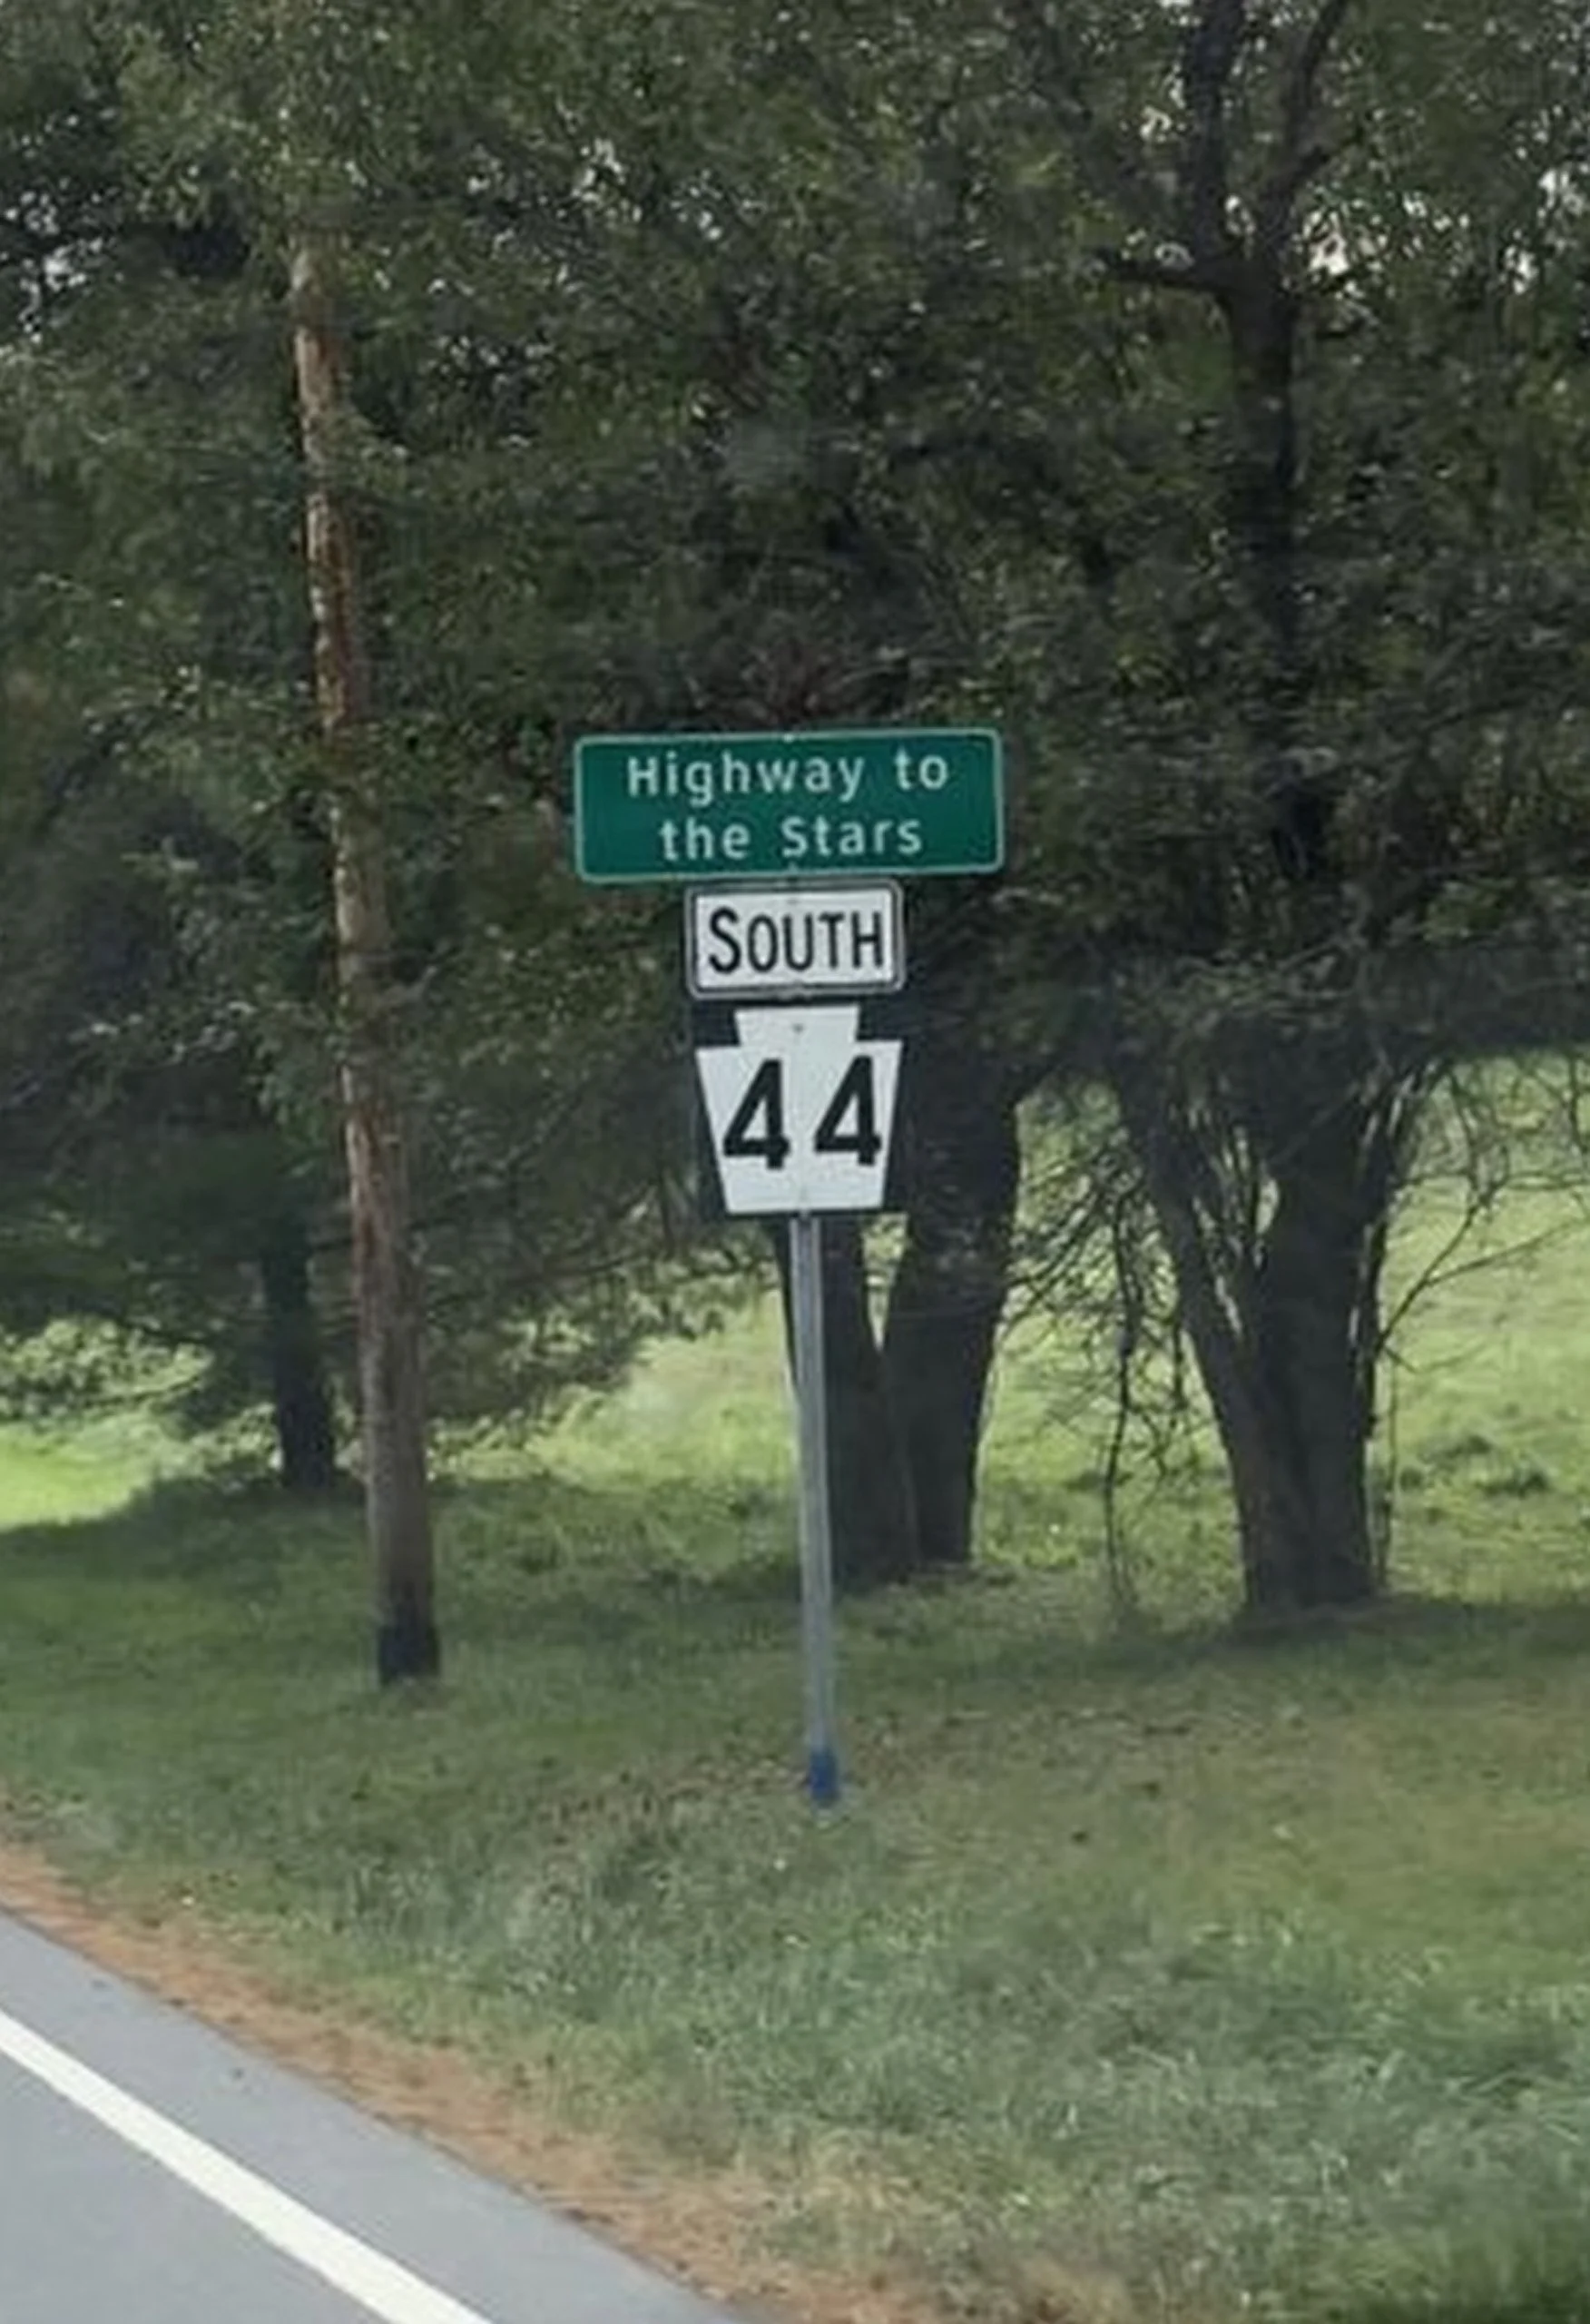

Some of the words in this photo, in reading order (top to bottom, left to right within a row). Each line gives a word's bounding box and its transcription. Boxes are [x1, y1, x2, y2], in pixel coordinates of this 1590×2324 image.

[627, 750, 864, 807] Highway
[893, 747, 948, 790] to
[659, 819, 751, 861] the
[780, 816, 922, 858] Stars
[708, 908, 883, 973] SOUTH
[723, 1055, 881, 1169] 44
